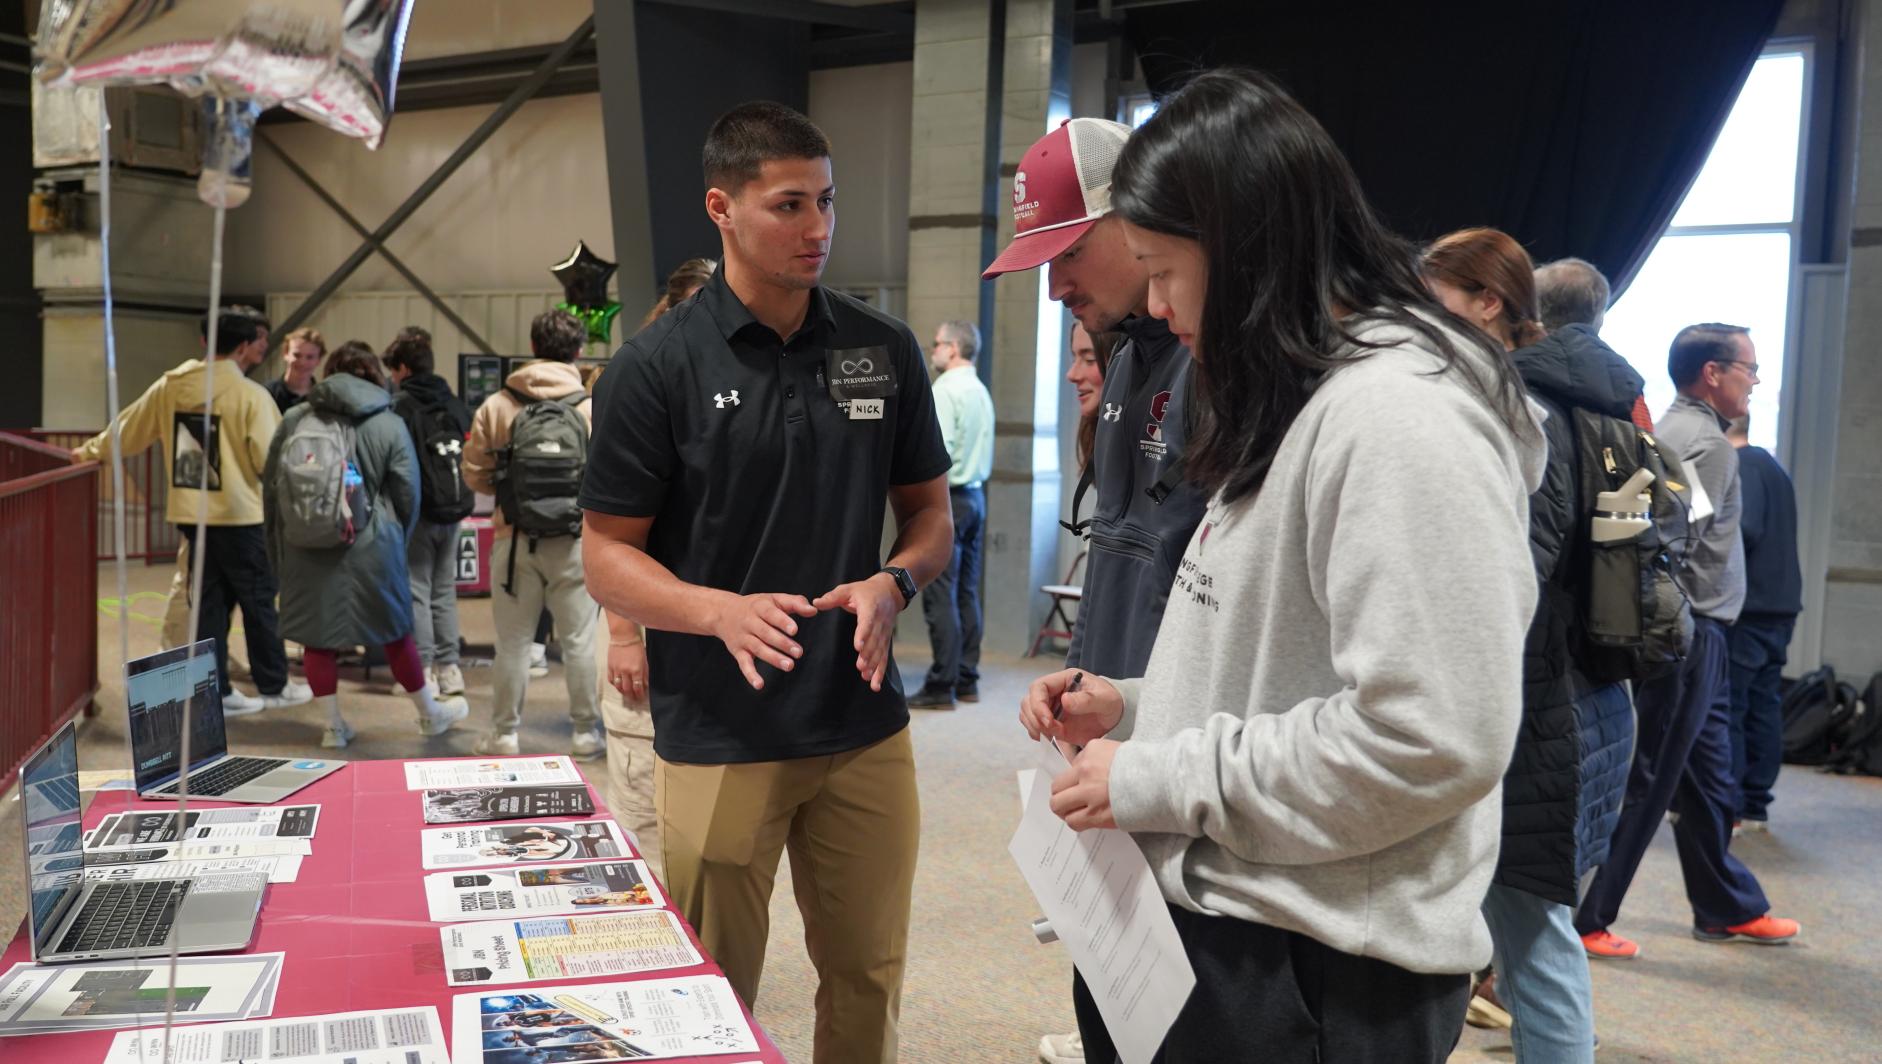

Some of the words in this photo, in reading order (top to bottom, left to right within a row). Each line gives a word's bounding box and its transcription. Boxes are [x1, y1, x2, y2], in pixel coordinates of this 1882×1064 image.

[1014, 172, 1026, 203] S
[843, 375, 889, 384] PERFORMANCE
[856, 405, 880, 414] NICK
[491, 935, 506, 951] Sheet
[496, 950, 511, 970] Pricing
